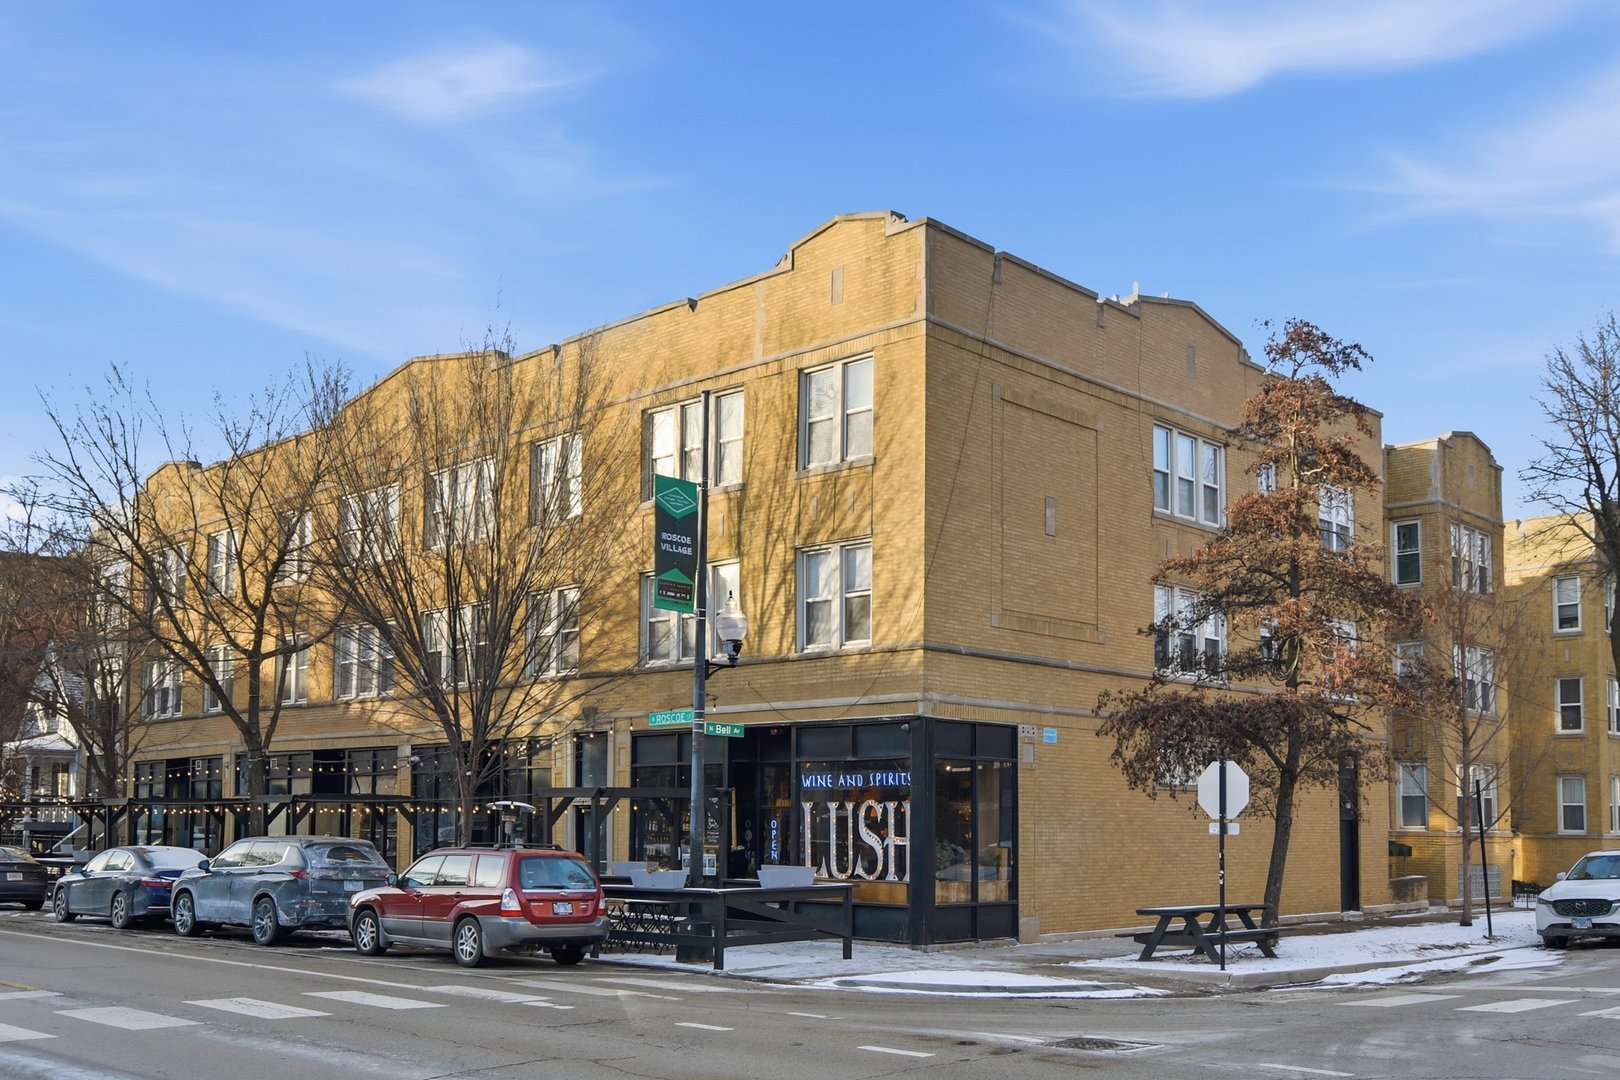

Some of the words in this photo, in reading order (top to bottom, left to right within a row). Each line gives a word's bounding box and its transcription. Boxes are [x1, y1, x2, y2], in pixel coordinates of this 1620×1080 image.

[661, 532, 692, 544] ROSCOE
[660, 542, 693, 555] VILLAGE
[656, 712, 686, 724] ROSCOE
[715, 724, 731, 735] Bell
[801, 774, 833, 788] WINE
[838, 774, 863, 786] AND
[770, 819, 778, 860] OPEN
[801, 799, 911, 881] LUSH
